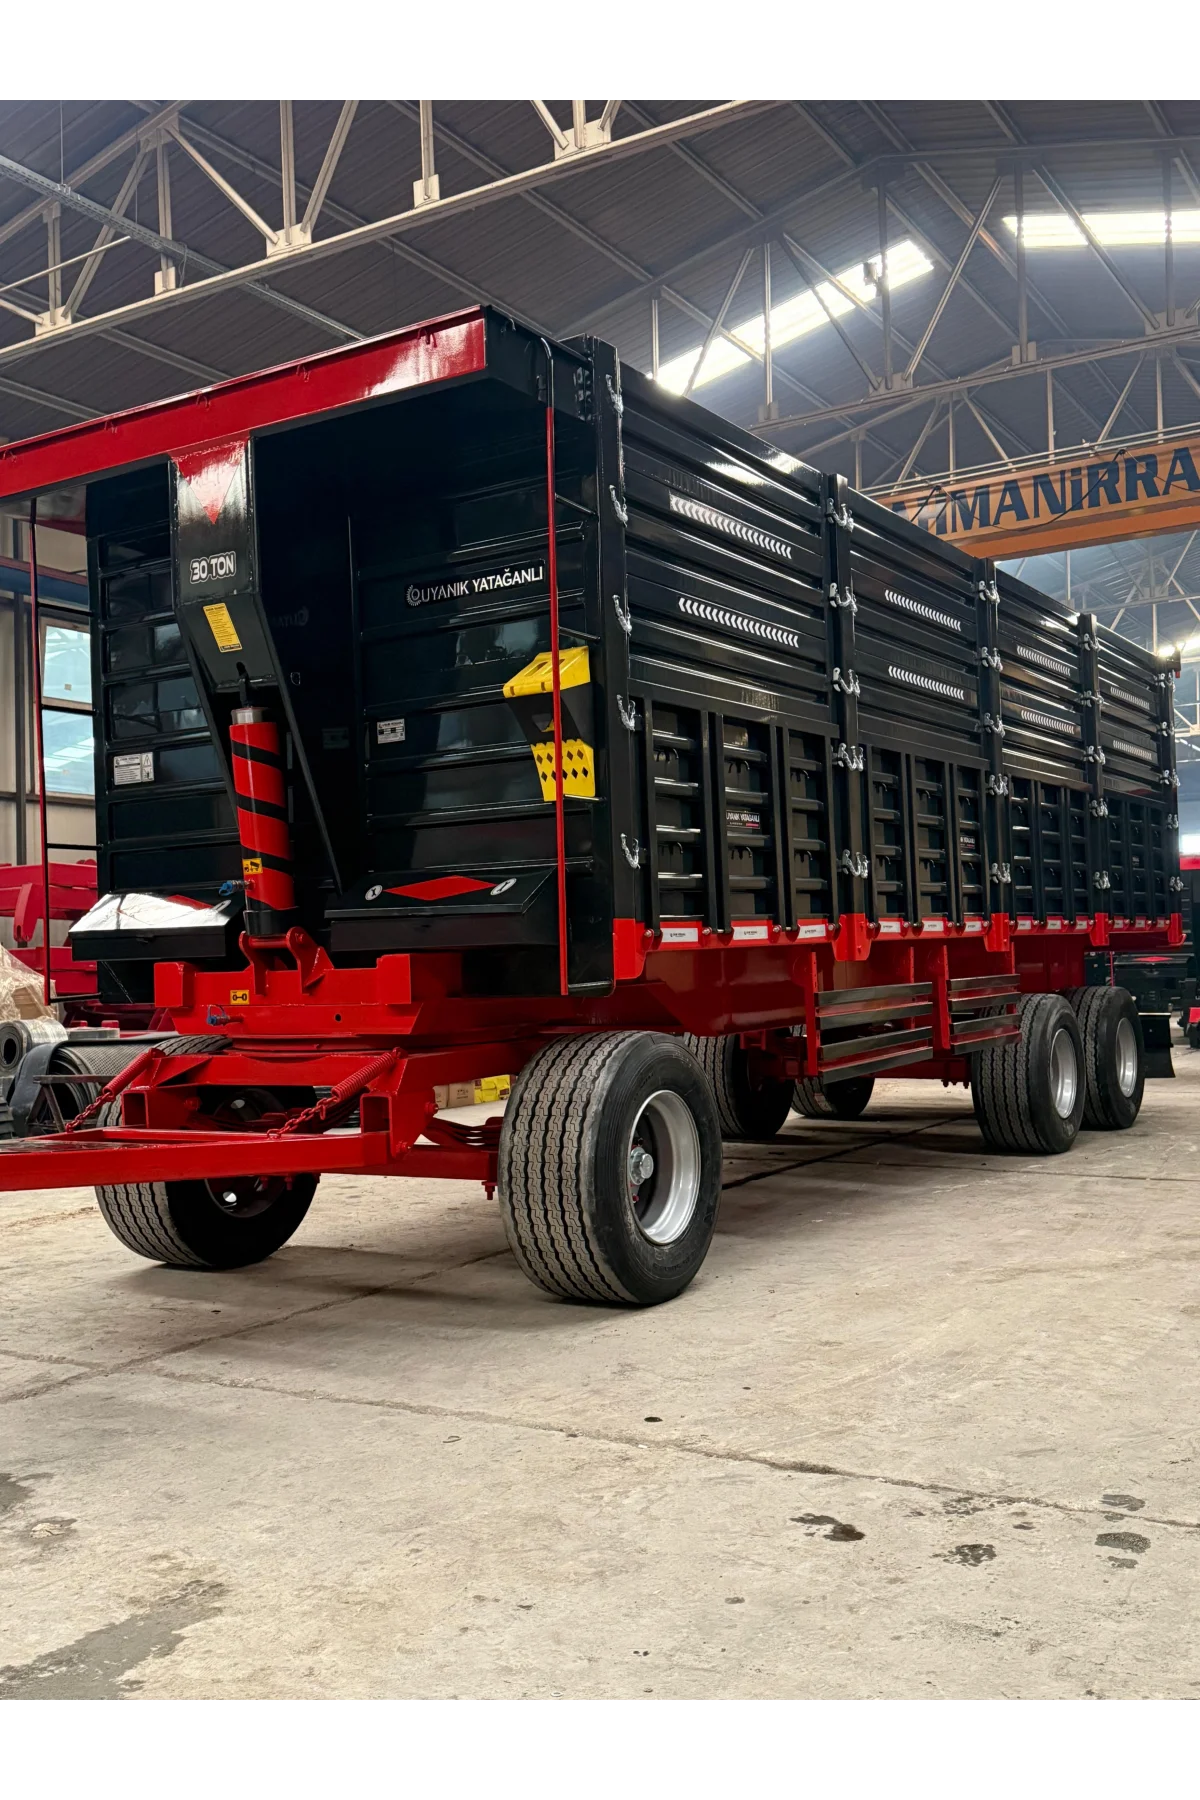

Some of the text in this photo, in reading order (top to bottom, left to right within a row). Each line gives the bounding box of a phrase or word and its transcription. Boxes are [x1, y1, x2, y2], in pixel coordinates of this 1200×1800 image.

[190, 552, 236, 582] 30 TON
[472, 566, 544, 592] YATAĞANLI
